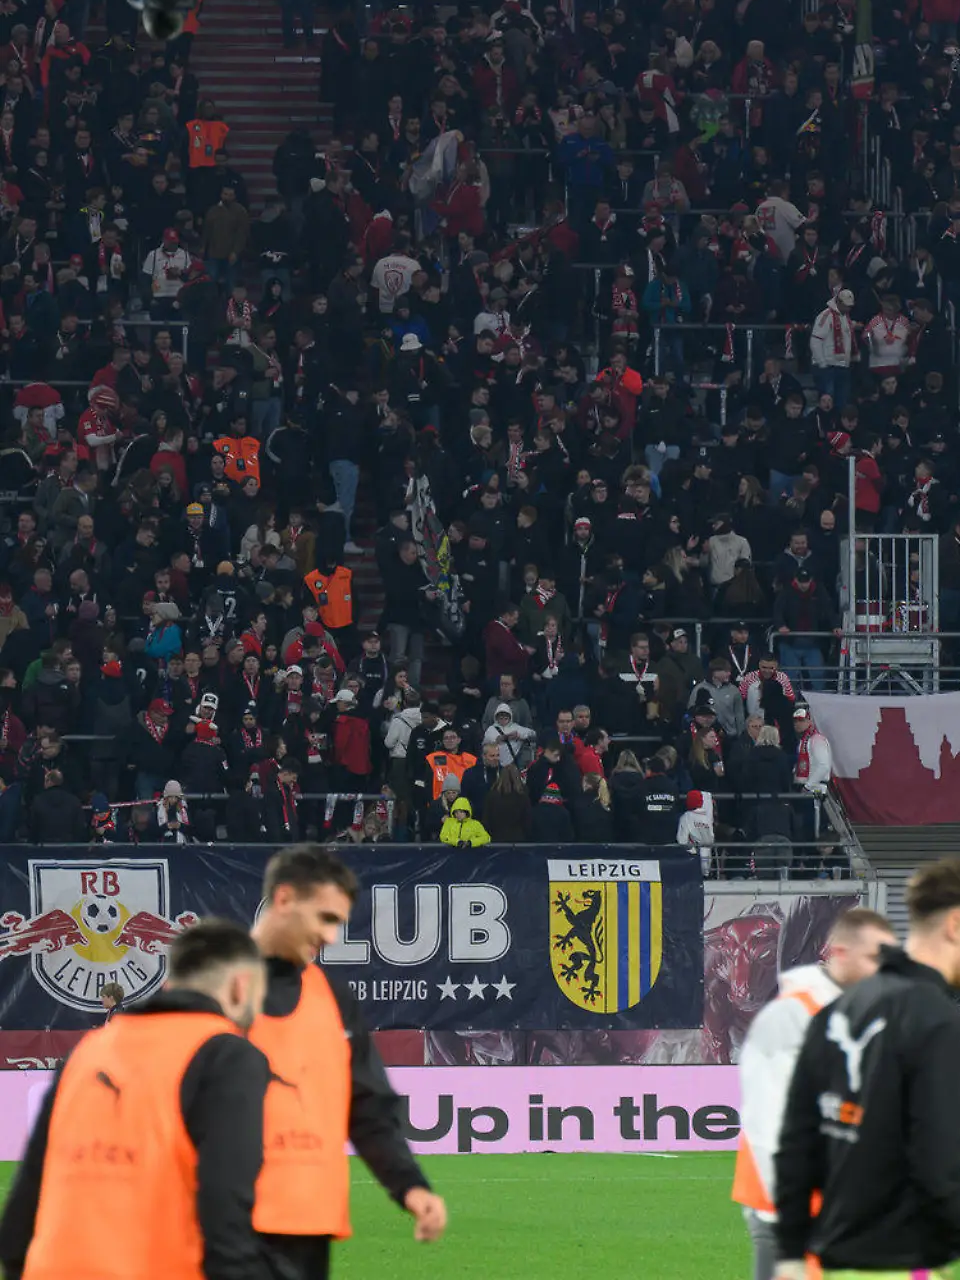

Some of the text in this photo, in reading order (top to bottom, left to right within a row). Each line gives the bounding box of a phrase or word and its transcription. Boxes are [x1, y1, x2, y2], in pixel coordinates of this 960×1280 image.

[568, 863, 641, 878] LEIPZIG
[80, 871, 121, 897] RB
[372, 980, 428, 1001] LEIPZIG
[399, 1094, 509, 1153] Up
[529, 1094, 594, 1141] in
[613, 1094, 741, 1141] the
